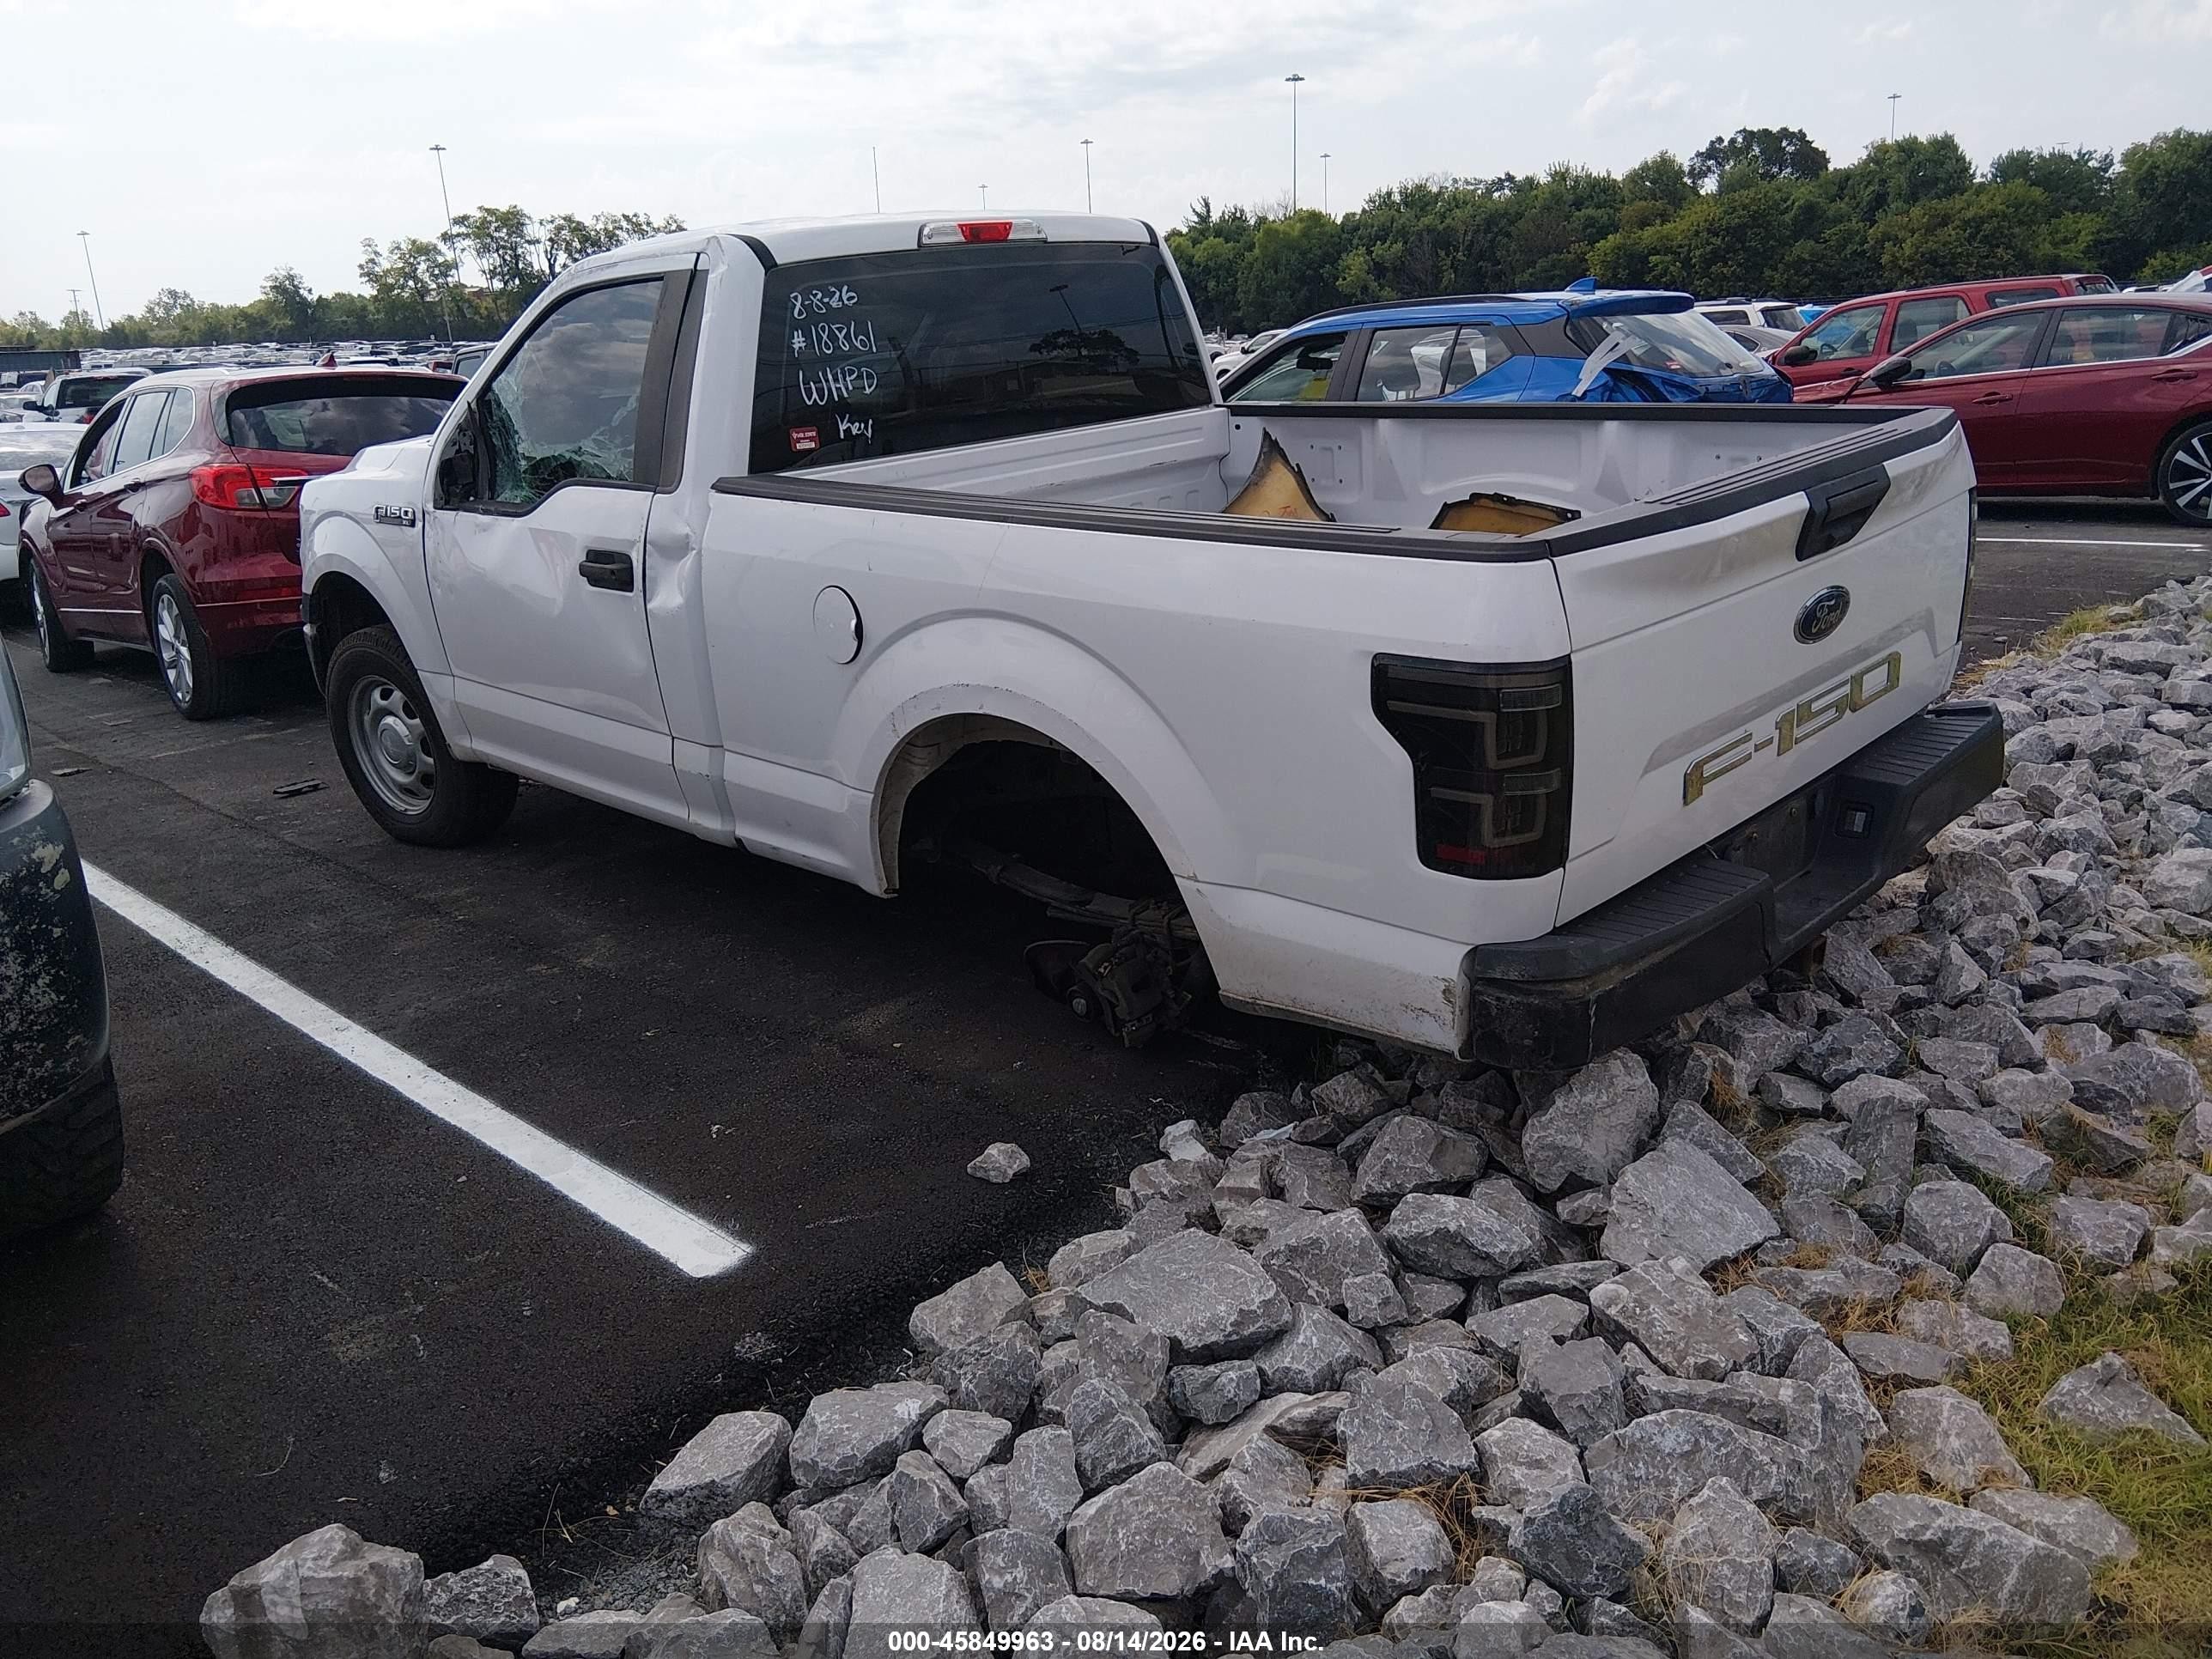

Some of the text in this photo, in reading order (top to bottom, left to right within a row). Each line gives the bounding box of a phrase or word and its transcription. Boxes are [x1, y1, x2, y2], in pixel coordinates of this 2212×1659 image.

[790, 285, 858, 319] 8-8-26
[792, 320, 877, 357] #18861
[799, 367, 877, 405] WHPD
[836, 414, 872, 444] Key
[1812, 599, 1843, 633] Ford
[1682, 651, 1901, 807] F-150
